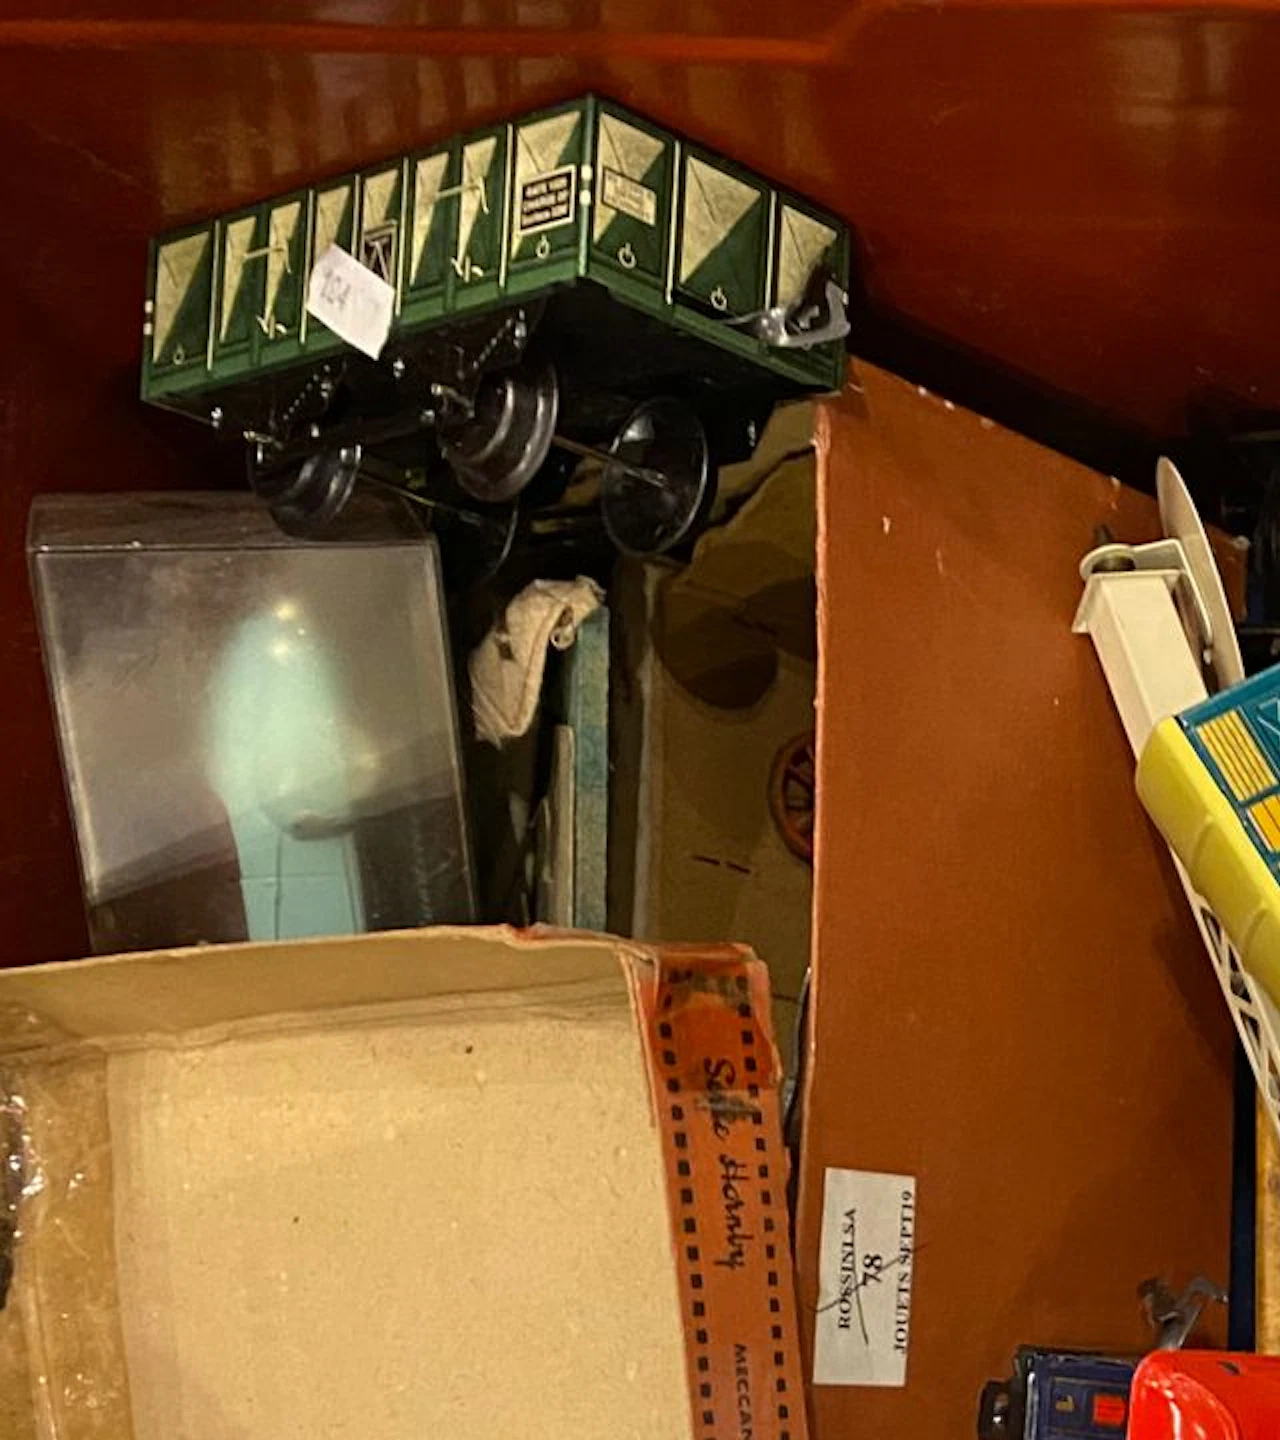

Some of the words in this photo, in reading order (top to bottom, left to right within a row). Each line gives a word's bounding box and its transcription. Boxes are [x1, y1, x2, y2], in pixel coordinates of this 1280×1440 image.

[714, 1153, 754, 1270] Hornby
[863, 1253, 883, 1287] 78
[894, 1272, 911, 1354] JOUETS
